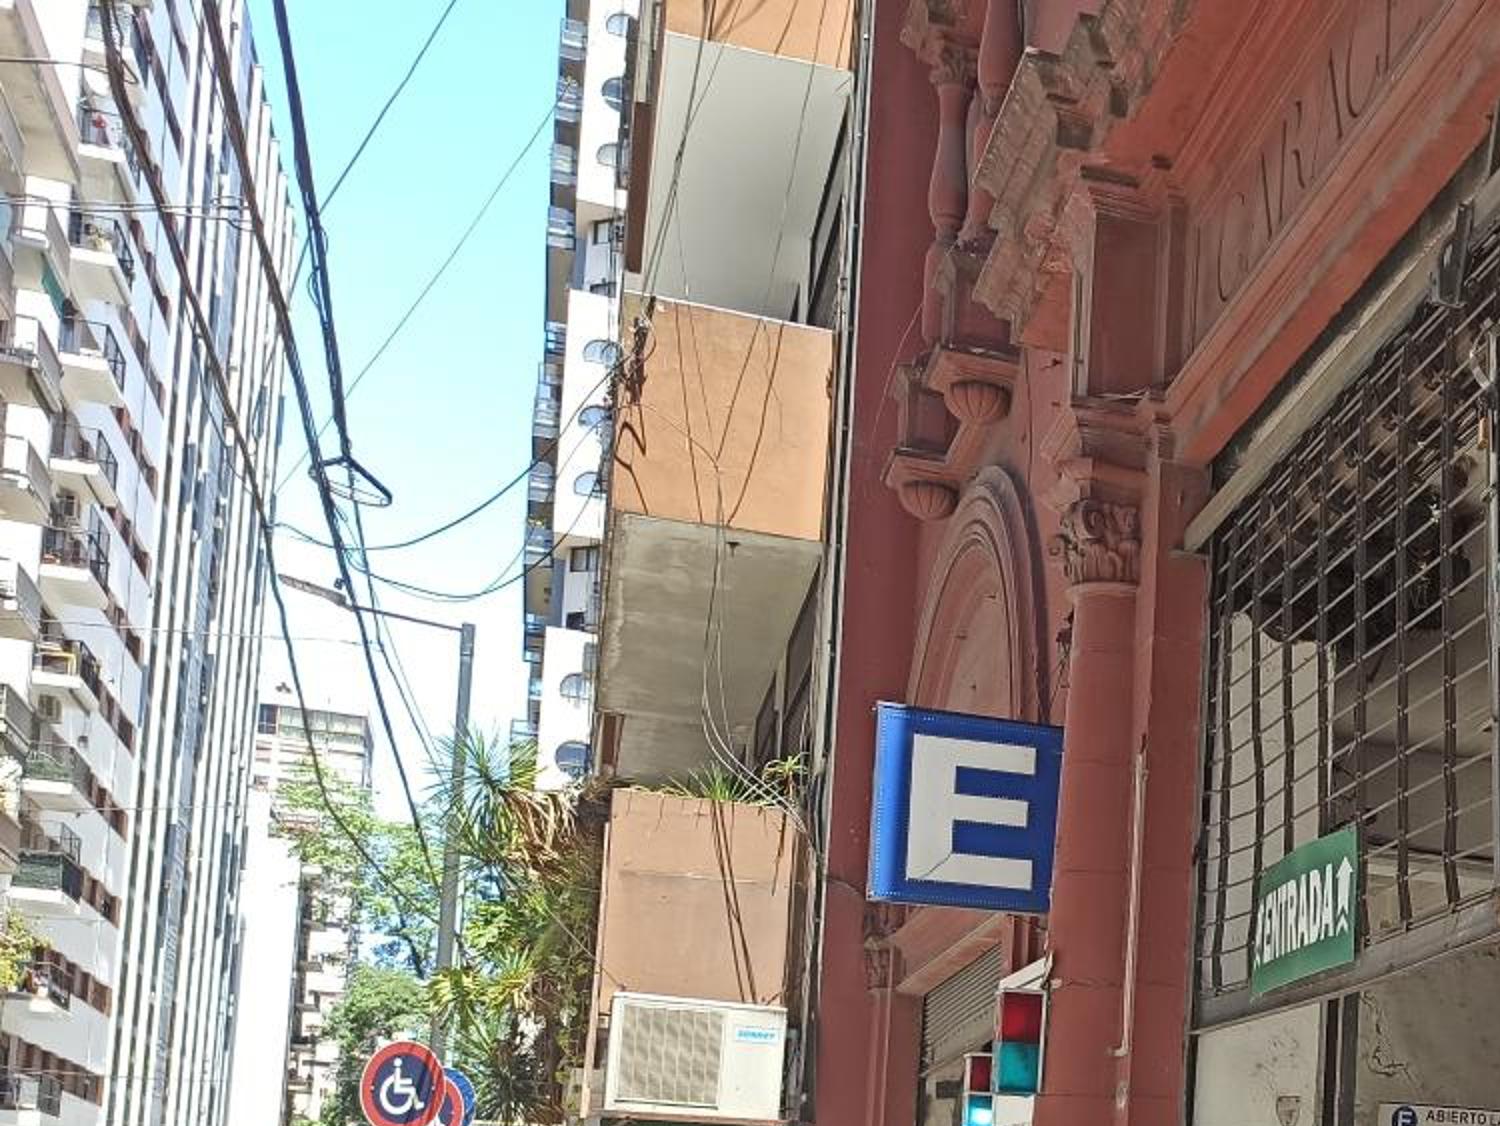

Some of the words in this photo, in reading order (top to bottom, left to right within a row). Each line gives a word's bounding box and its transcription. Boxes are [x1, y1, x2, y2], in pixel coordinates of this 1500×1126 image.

[906, 733, 1037, 891] E
[1263, 864, 1334, 965] ENTRADA
[1425, 1110, 1487, 1125] ABIERTO
